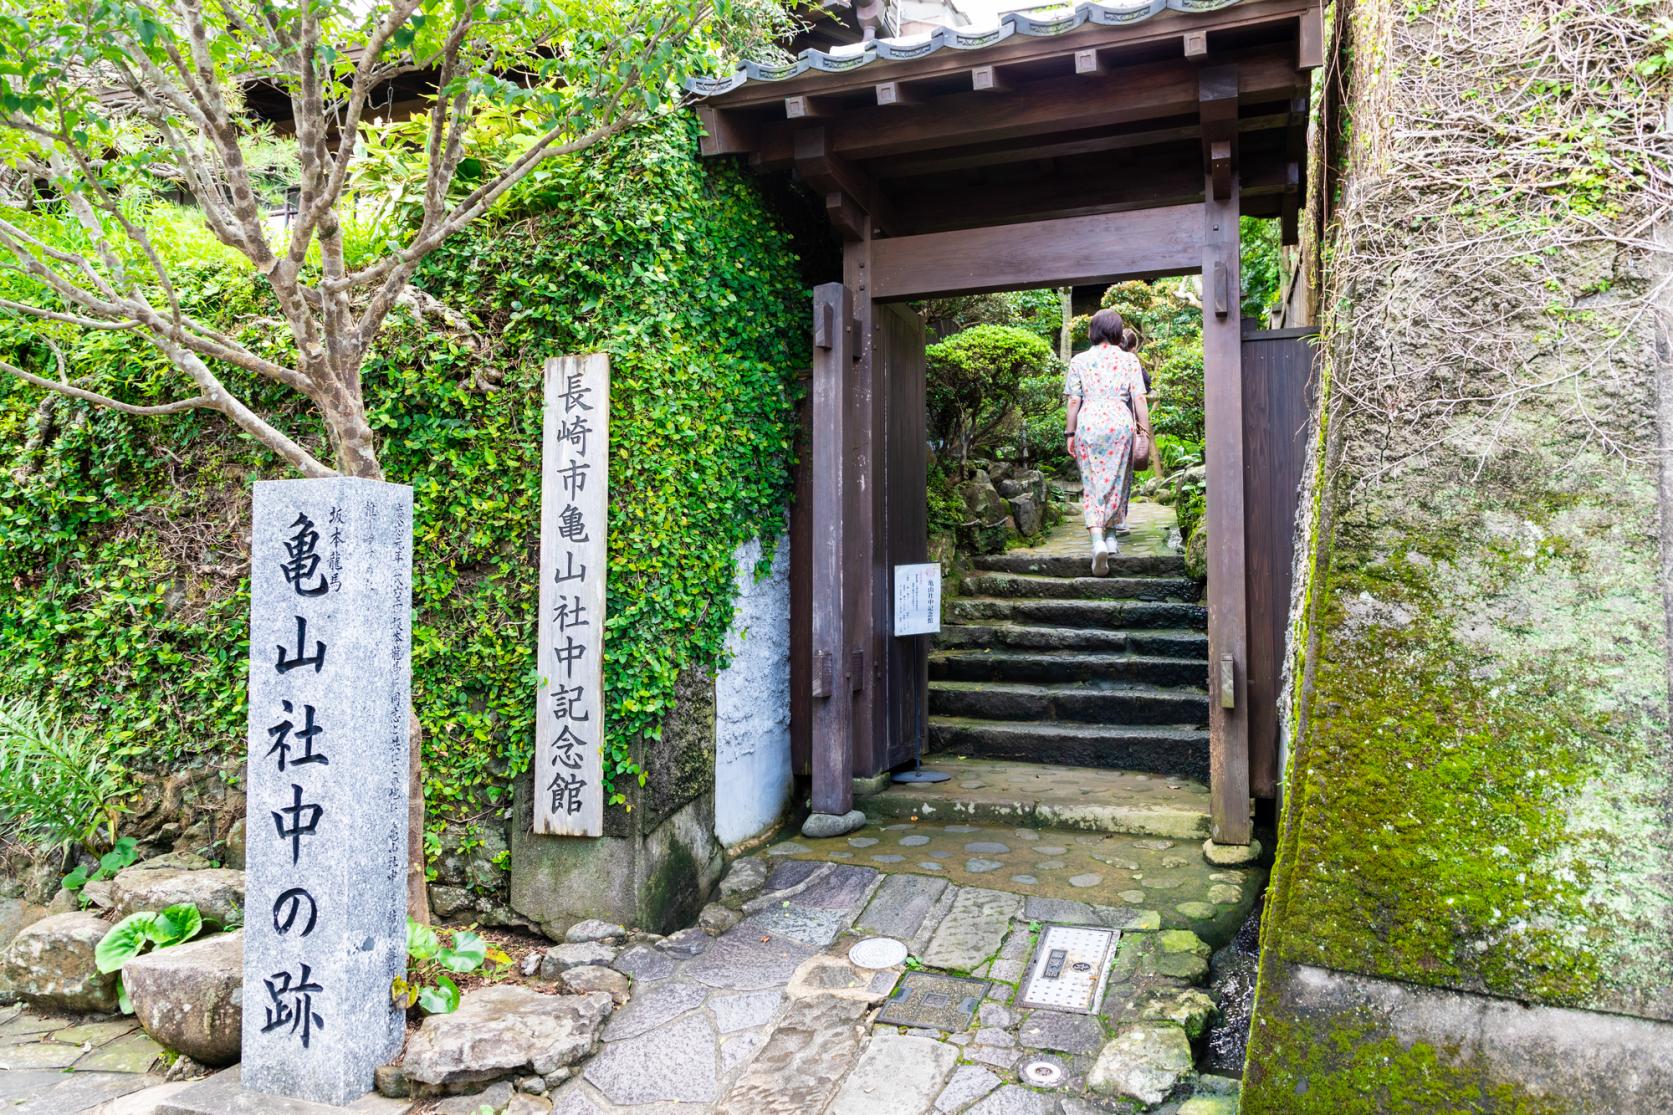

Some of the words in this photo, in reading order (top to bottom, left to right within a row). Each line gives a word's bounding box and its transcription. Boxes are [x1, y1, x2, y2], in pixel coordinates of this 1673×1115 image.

[328, 506, 346, 593] 坂本龍馬
[546, 372, 593, 817] 長崎市亀山社中記念館
[260, 511, 330, 1049] 亀山社中の跡
